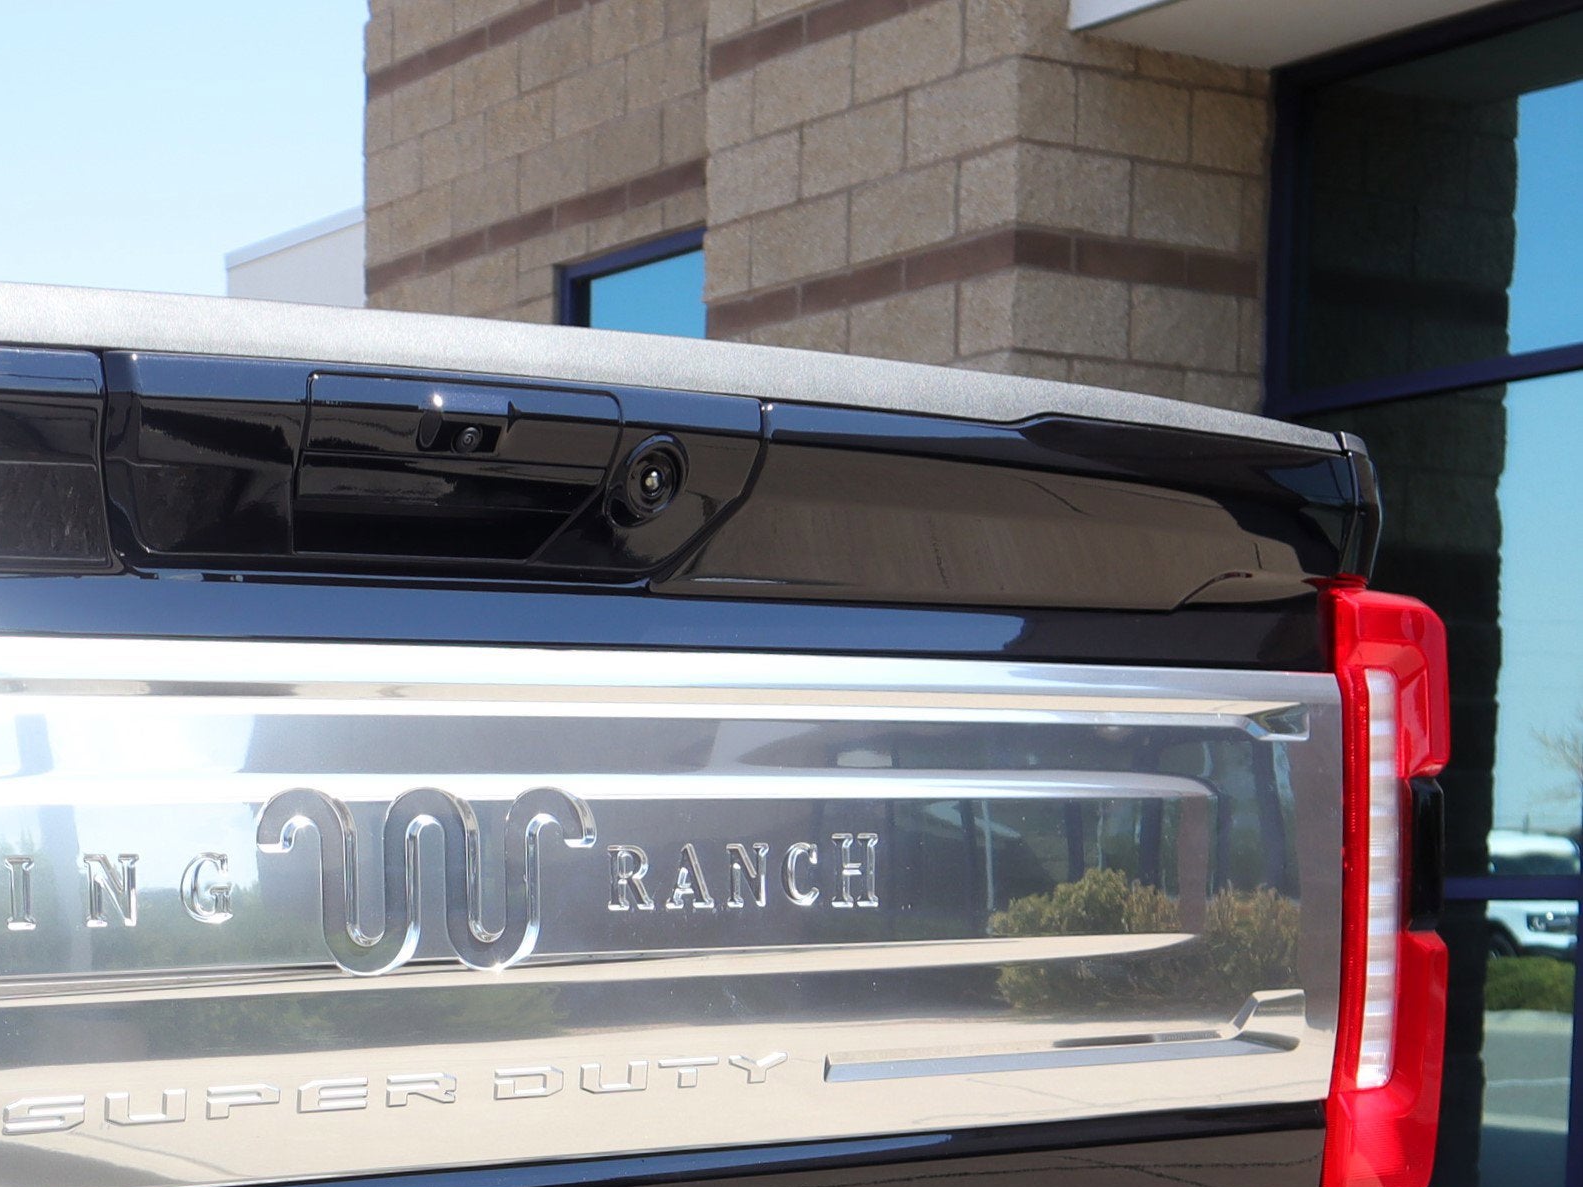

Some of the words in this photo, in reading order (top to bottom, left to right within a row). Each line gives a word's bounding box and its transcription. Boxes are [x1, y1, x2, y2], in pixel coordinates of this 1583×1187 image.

[606, 832, 880, 911] RANCH
[2, 1072, 458, 1136] SUPER
[493, 1050, 789, 1101] DUTY
